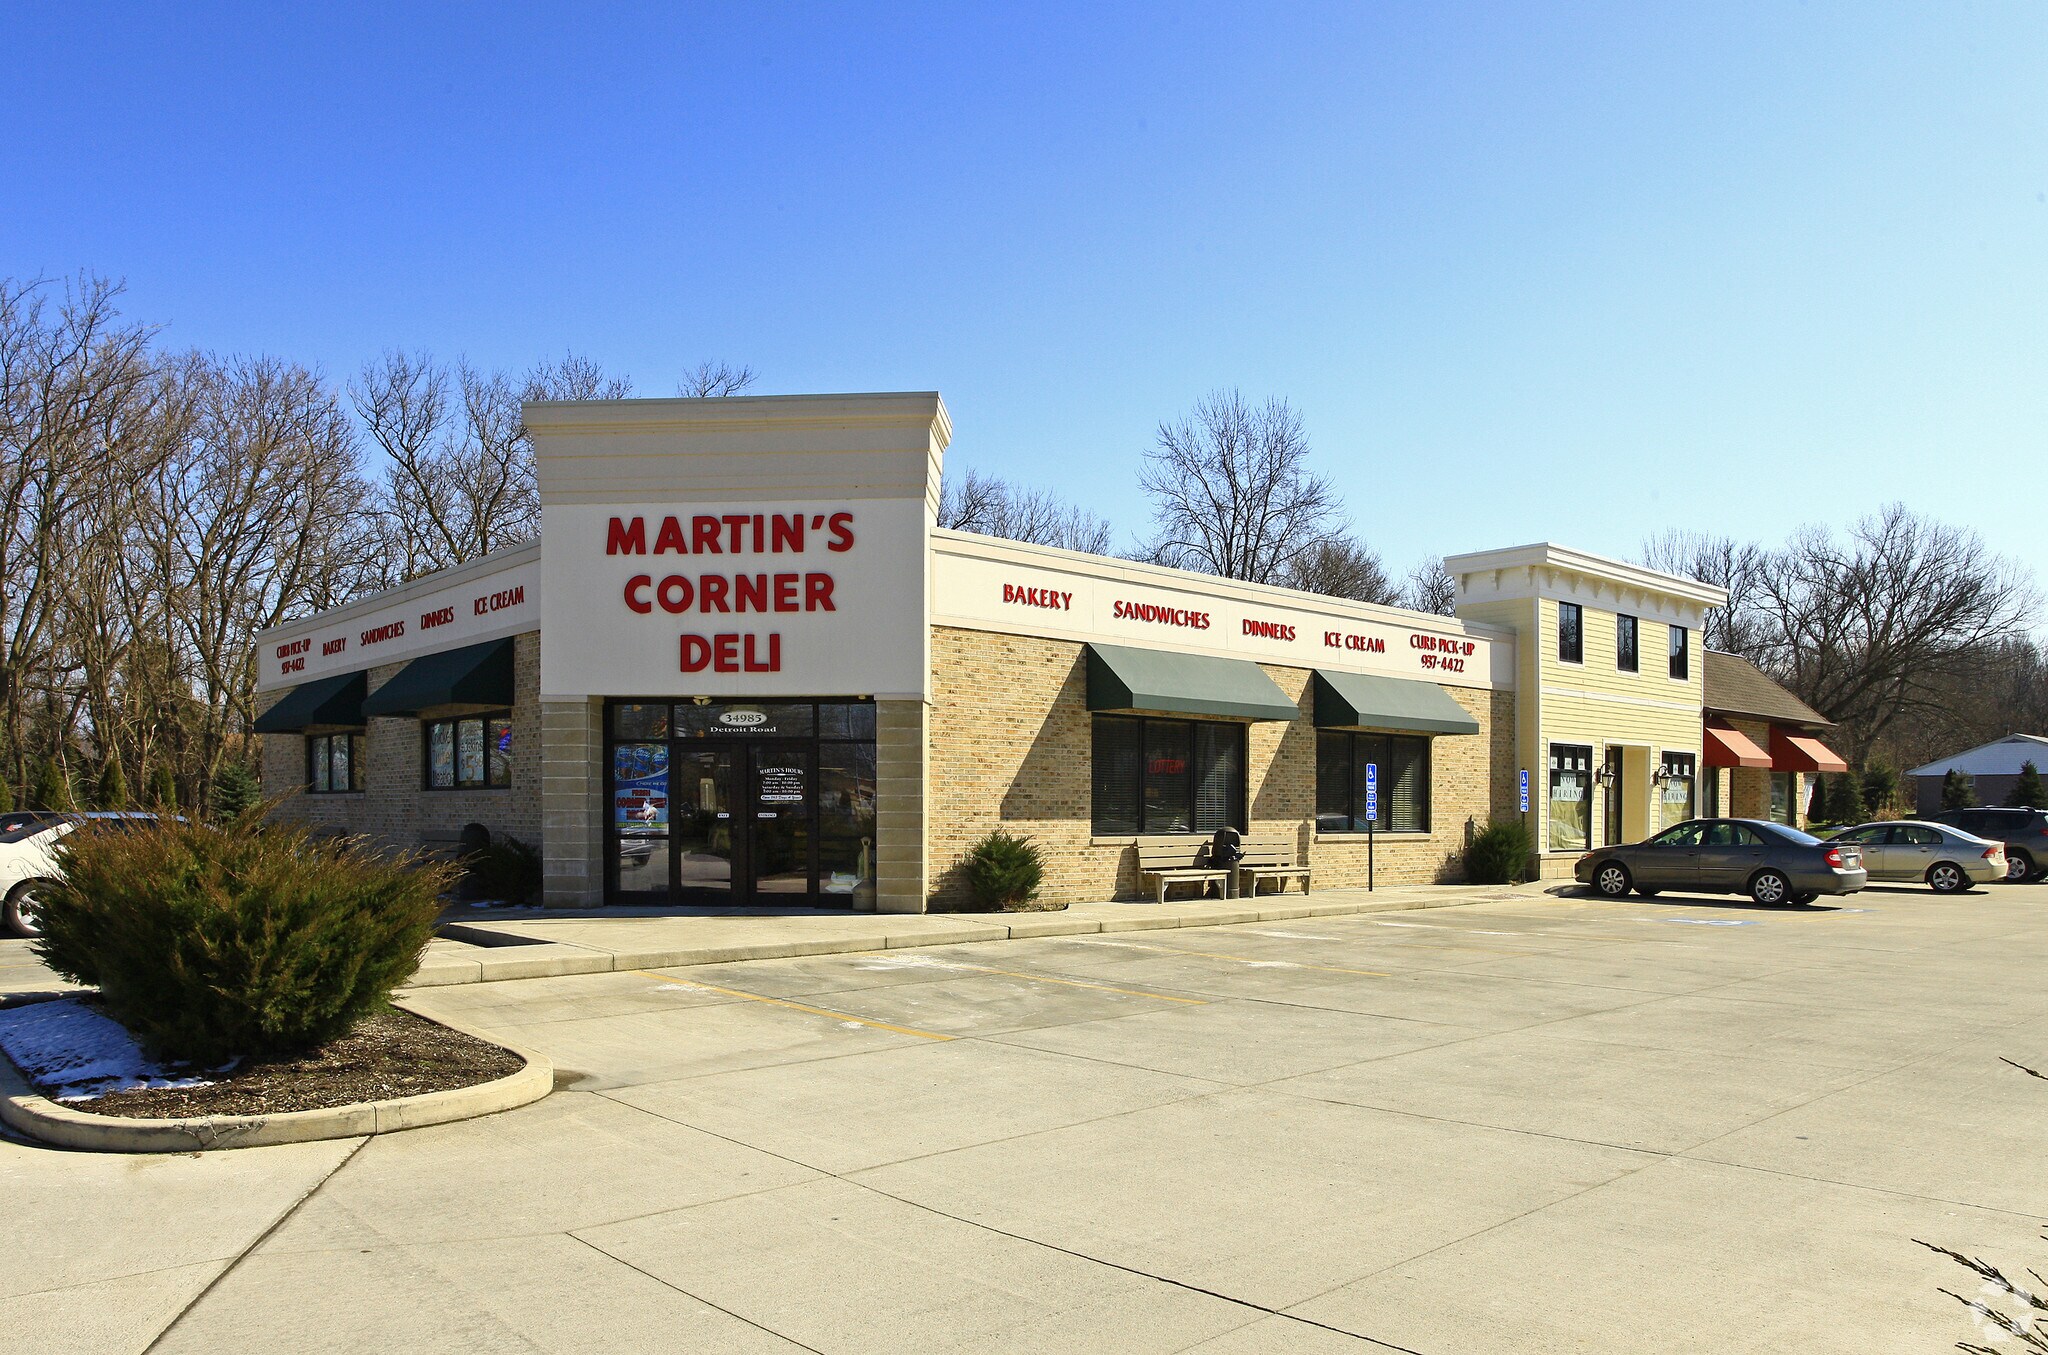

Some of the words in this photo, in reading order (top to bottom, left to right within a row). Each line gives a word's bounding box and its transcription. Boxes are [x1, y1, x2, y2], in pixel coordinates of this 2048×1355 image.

[606, 512, 854, 555] MARTIN'S
[474, 597, 488, 616] ICE
[490, 586, 524, 612] CREAM
[624, 573, 836, 614] CORNER
[1003, 583, 1072, 611] BAKERY
[420, 606, 454, 630] DINNERS
[1113, 600, 1210, 629] SANDWICHES
[361, 621, 404, 646] SANDWICHES
[1242, 619, 1296, 642] DINNERS
[276, 644, 290, 659] CURB
[323, 637, 346, 656] BAKERY
[680, 633, 781, 673] DELI
[1324, 631, 1342, 648] ICE
[1345, 634, 1385, 654] CREAM
[1410, 634, 1437, 651] CURB
[1438, 638, 1475, 657] PICK-UP
[1421, 654, 1464, 673] 937-4422
[725, 714, 762, 723] 34985
[760, 767, 784, 775] MARTIN'S
[1561, 776, 1576, 784] NOW
[1553, 787, 1583, 799] HIRING
